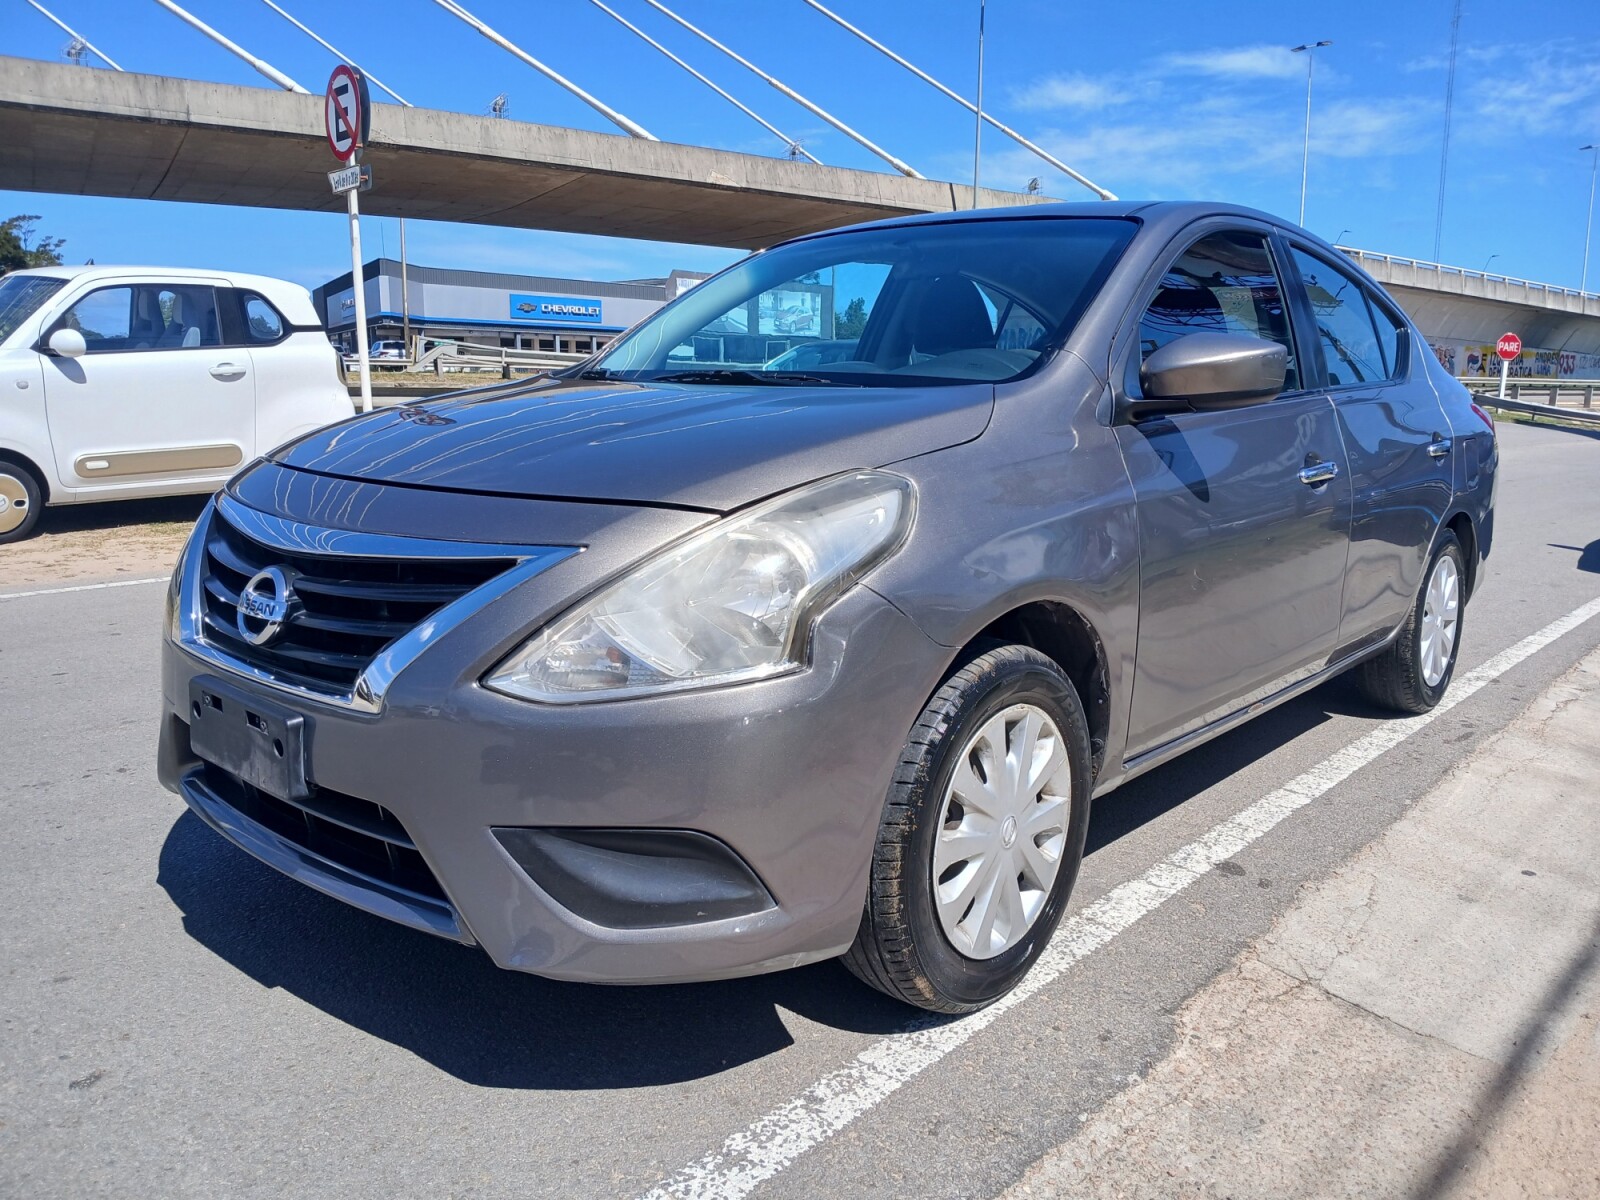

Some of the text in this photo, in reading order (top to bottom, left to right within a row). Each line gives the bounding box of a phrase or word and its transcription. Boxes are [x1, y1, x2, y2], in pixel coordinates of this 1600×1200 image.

[541, 303, 600, 315] CHEVROLET
[1498, 341, 1520, 352] PARE
[1489, 363, 1532, 378] DEMRATICA
[1558, 354, 1576, 374] 933
[240, 594, 276, 616] SSAN
